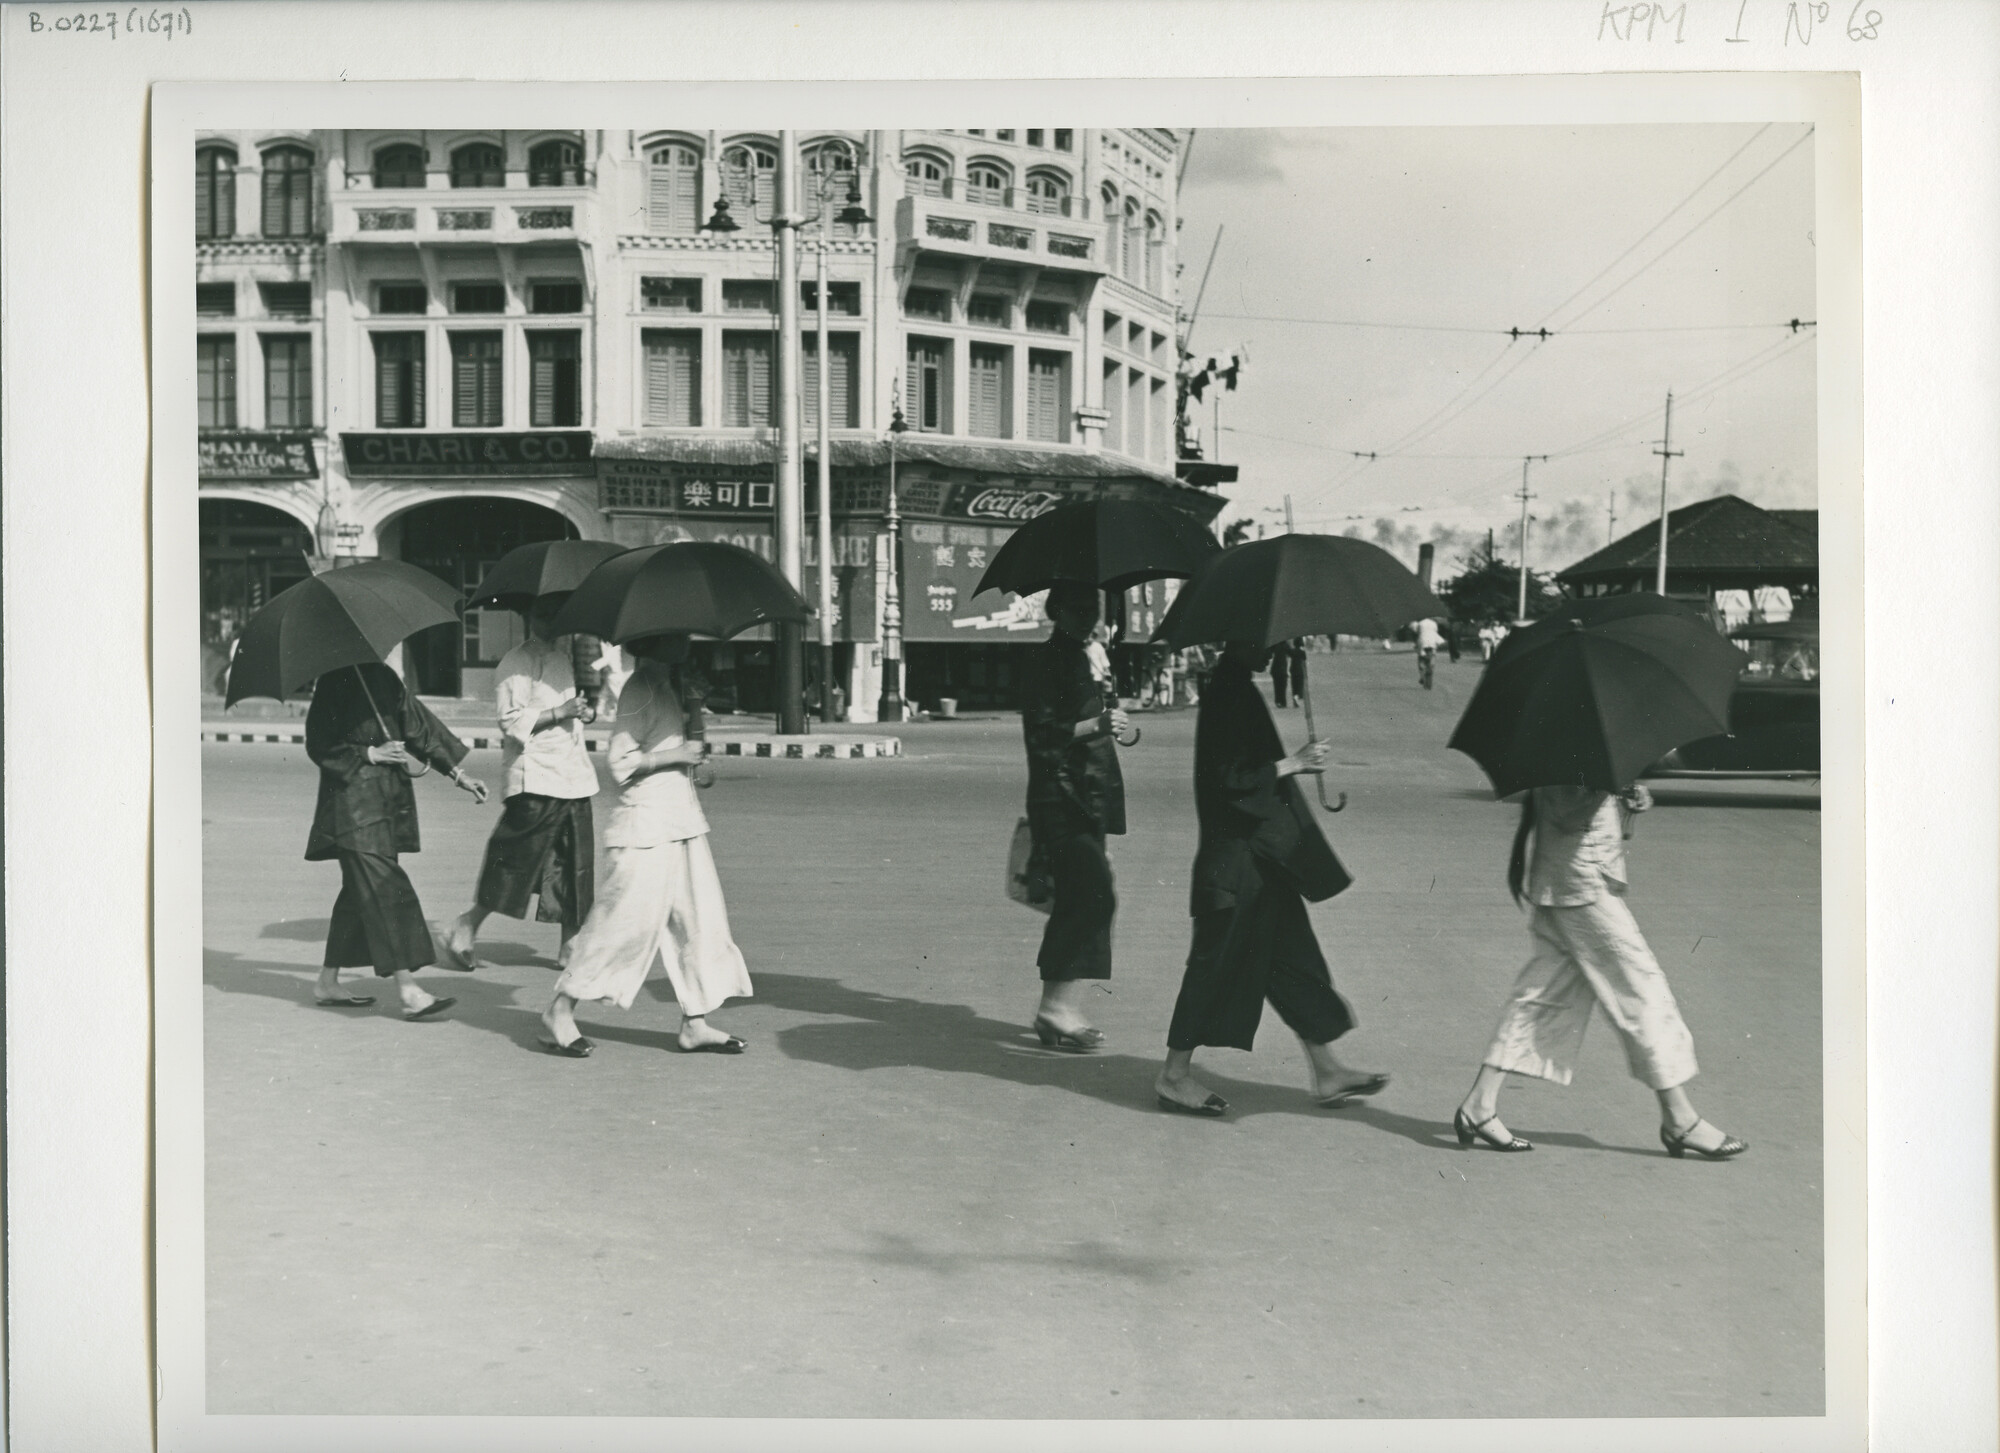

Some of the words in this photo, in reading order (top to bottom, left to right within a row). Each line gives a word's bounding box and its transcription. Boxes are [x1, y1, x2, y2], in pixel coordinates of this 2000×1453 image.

[1597, 2, 1686, 43] KPM
[1847, 0, 1882, 41] 68
[362, 438, 474, 462] CHARI
[484, 438, 509, 461] &
[519, 437, 576, 460] CO.
